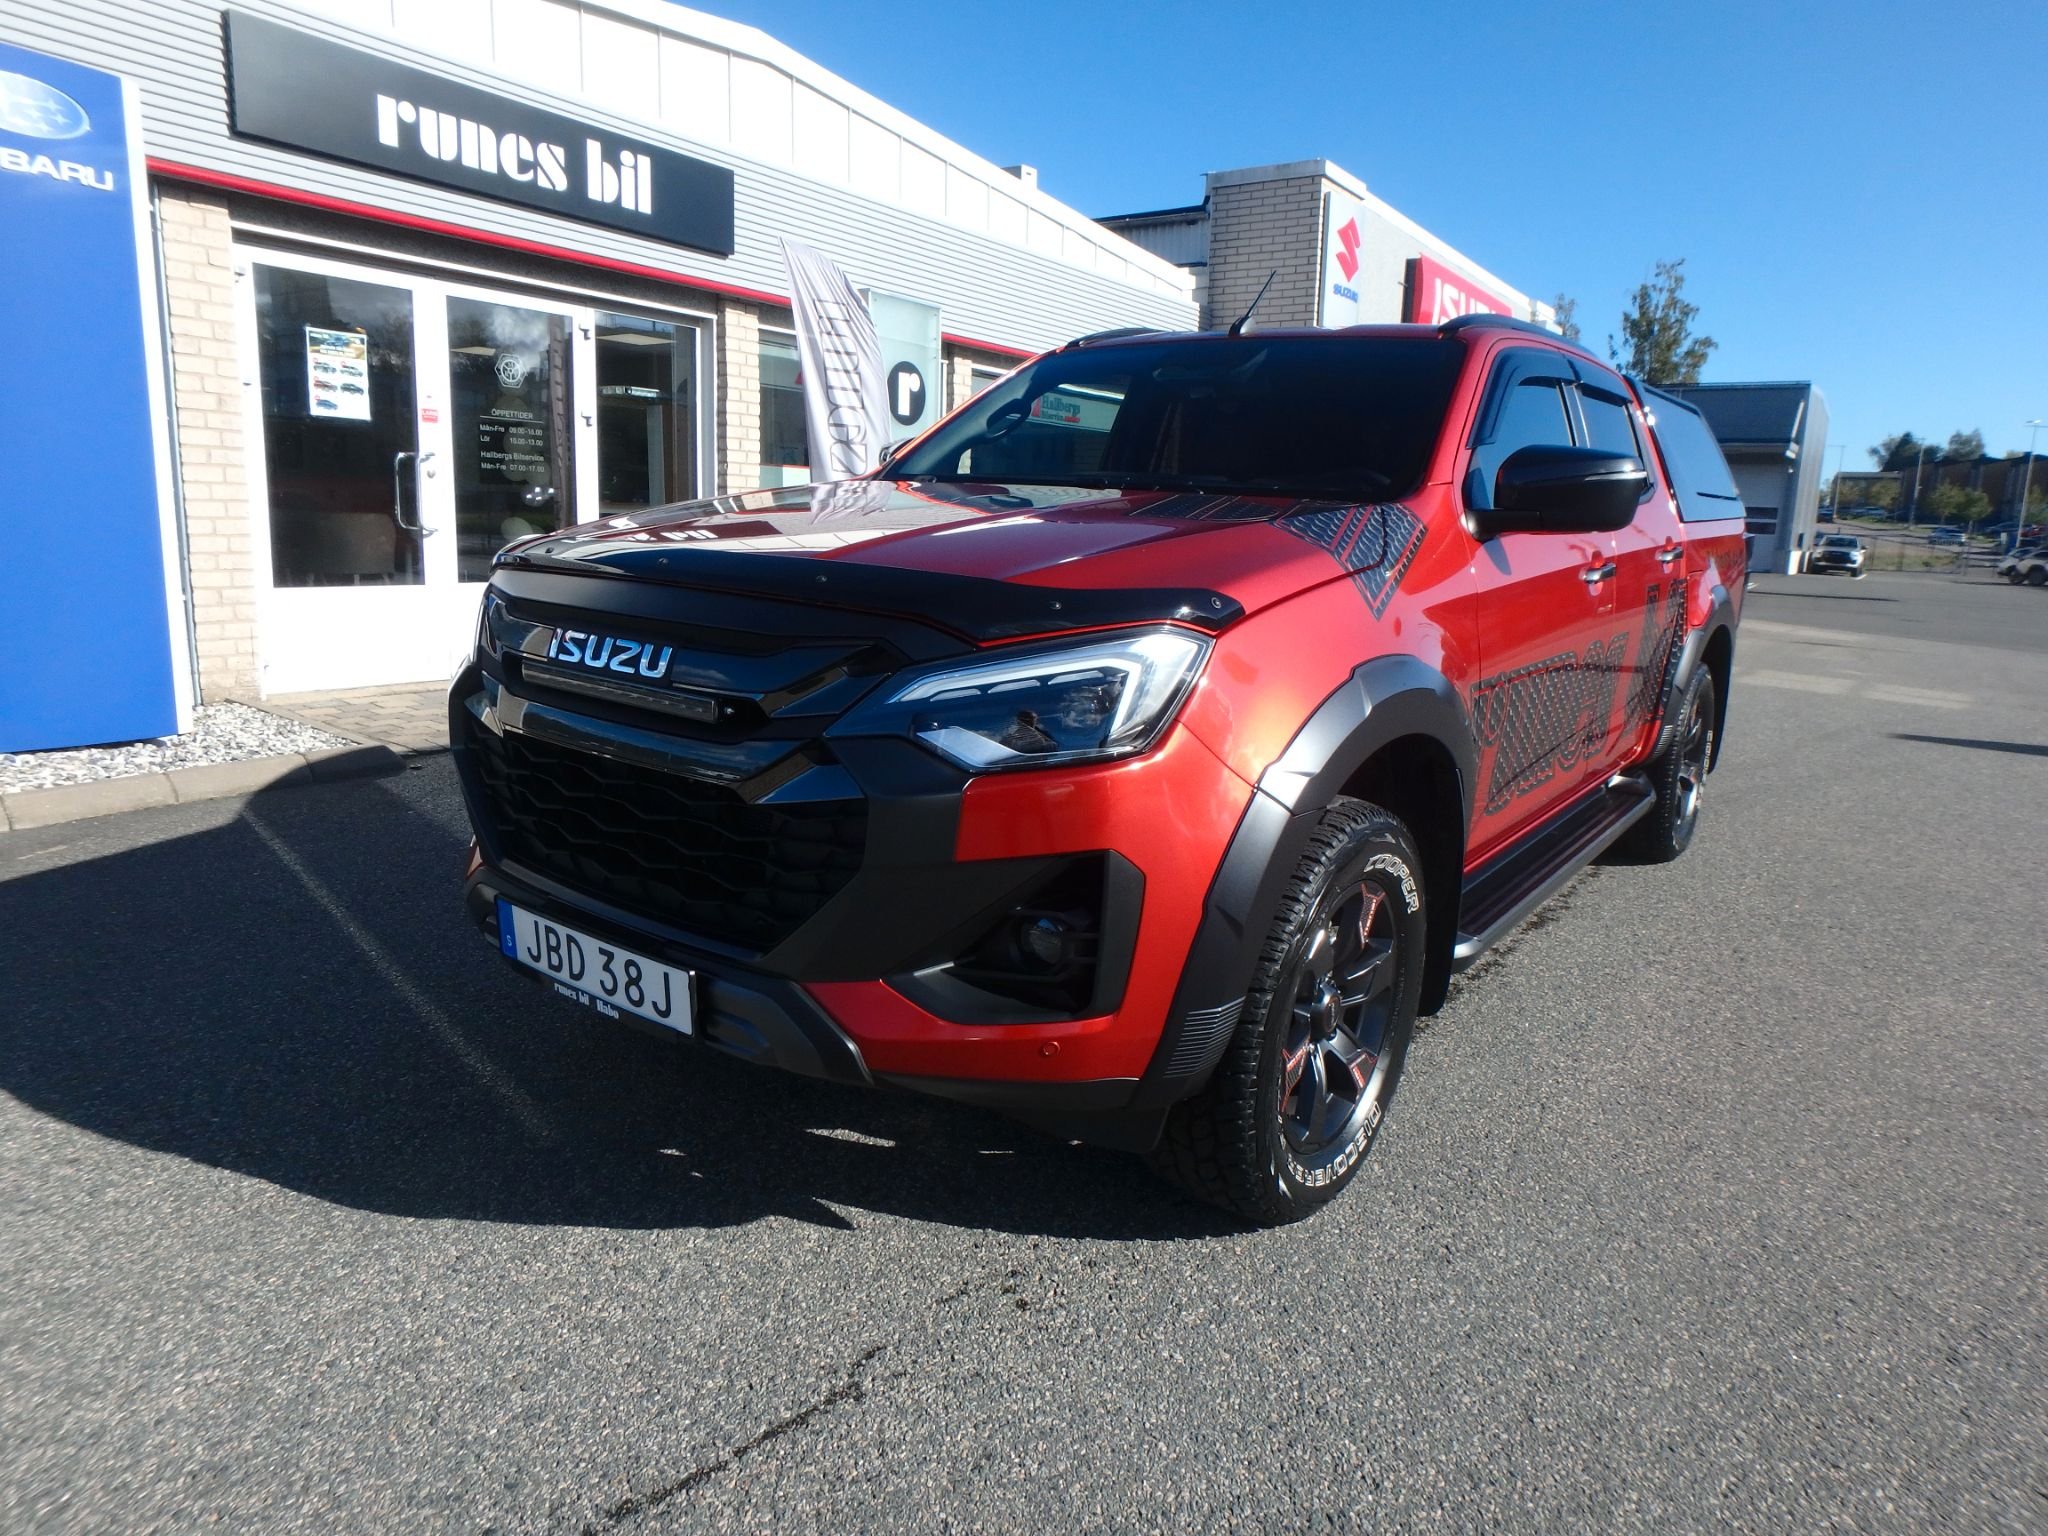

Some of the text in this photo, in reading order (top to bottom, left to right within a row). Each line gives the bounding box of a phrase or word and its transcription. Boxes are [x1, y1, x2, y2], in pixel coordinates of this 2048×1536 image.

[377, 93, 652, 216] runes bil
[1431, 277, 1497, 326] ISU
[491, 408, 533, 419] ÖPPETTIDER
[898, 371, 921, 416] r
[549, 628, 673, 678] ISUZU
[1363, 853, 1420, 915] COOPER
[506, 935, 513, 947] S
[527, 920, 672, 1019] JBD 38J
